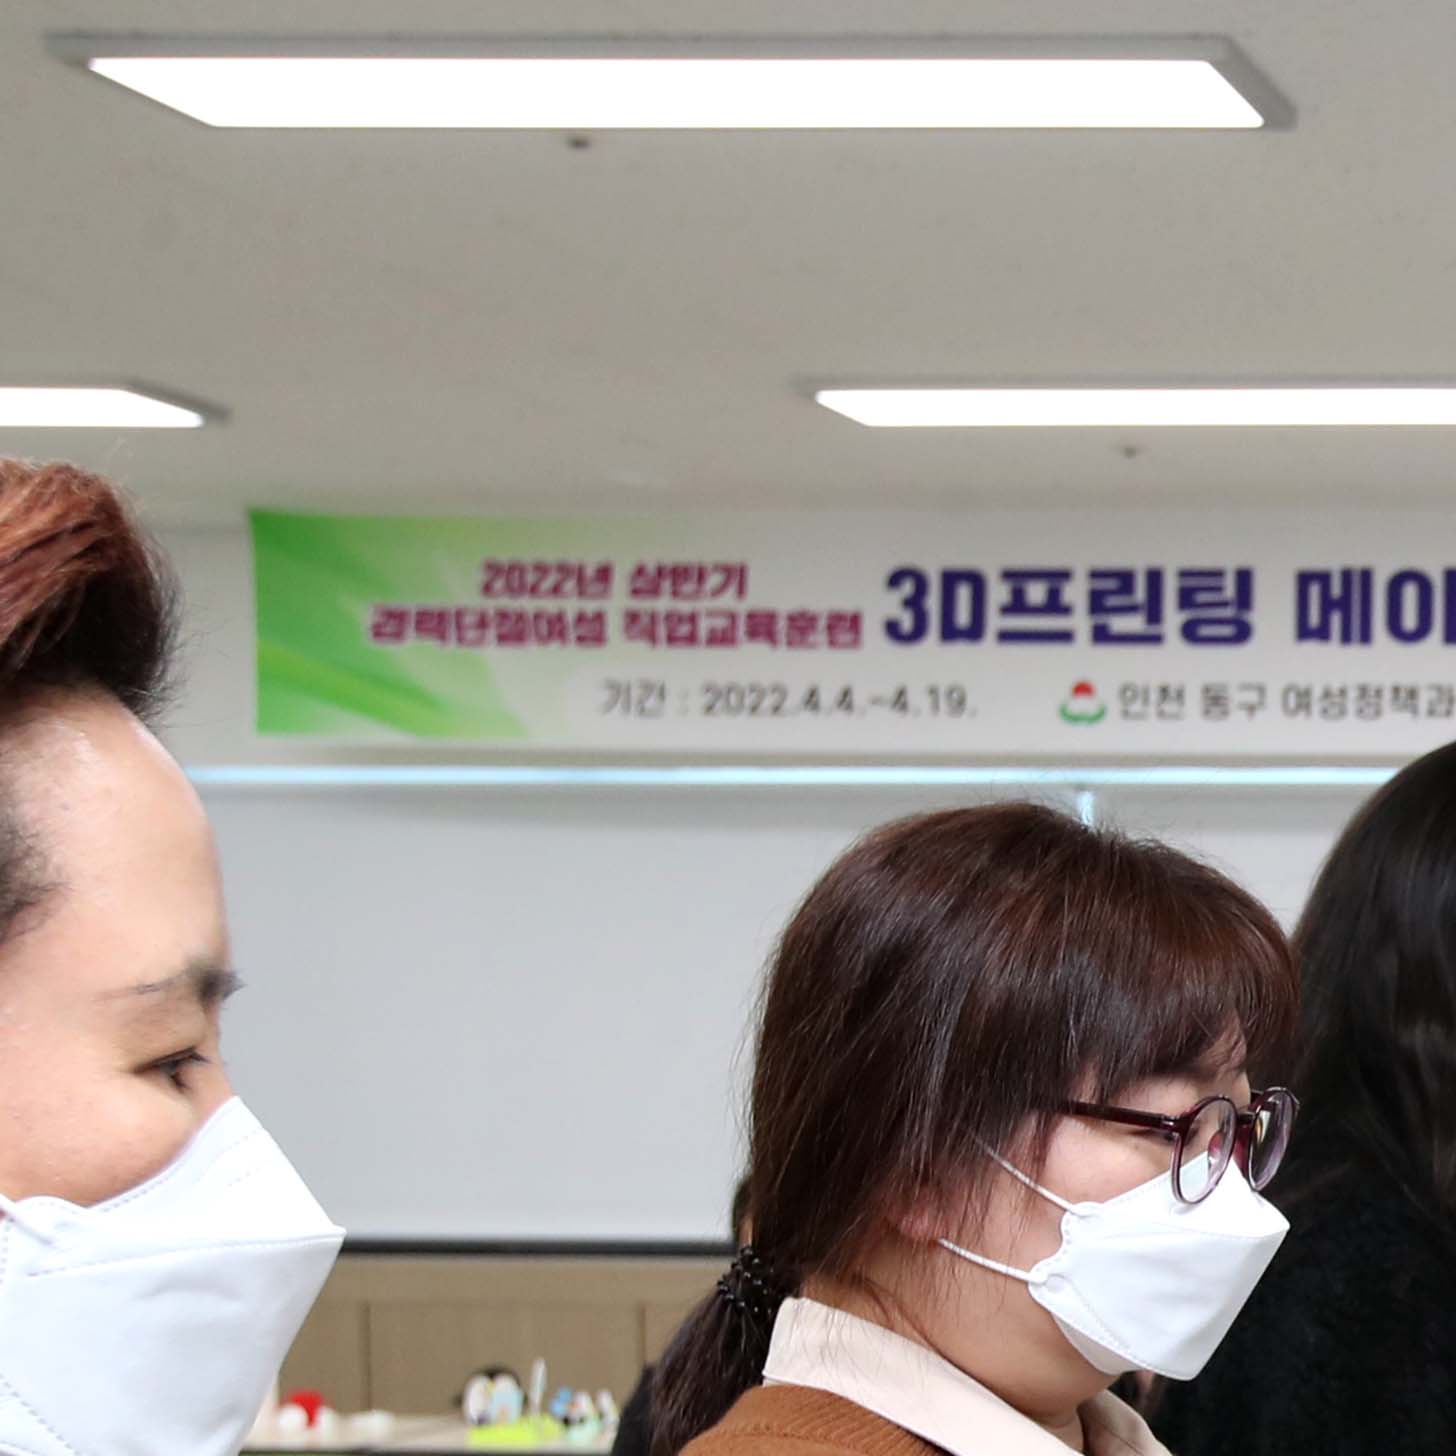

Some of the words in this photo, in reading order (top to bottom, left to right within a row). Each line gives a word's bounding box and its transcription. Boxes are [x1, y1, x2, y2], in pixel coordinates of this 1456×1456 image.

[481, 560, 614, 598] 2022년
[628, 560, 748, 600] 상반기
[884, 567, 1255, 646] 3D프린팅
[623, 608, 863, 650] 직업교육훈련
[602, 679, 666, 718] 기간
[1118, 682, 1185, 720] 인천
[1201, 682, 1266, 720] 동구
[1281, 682, 1455, 720] 여성정책과
